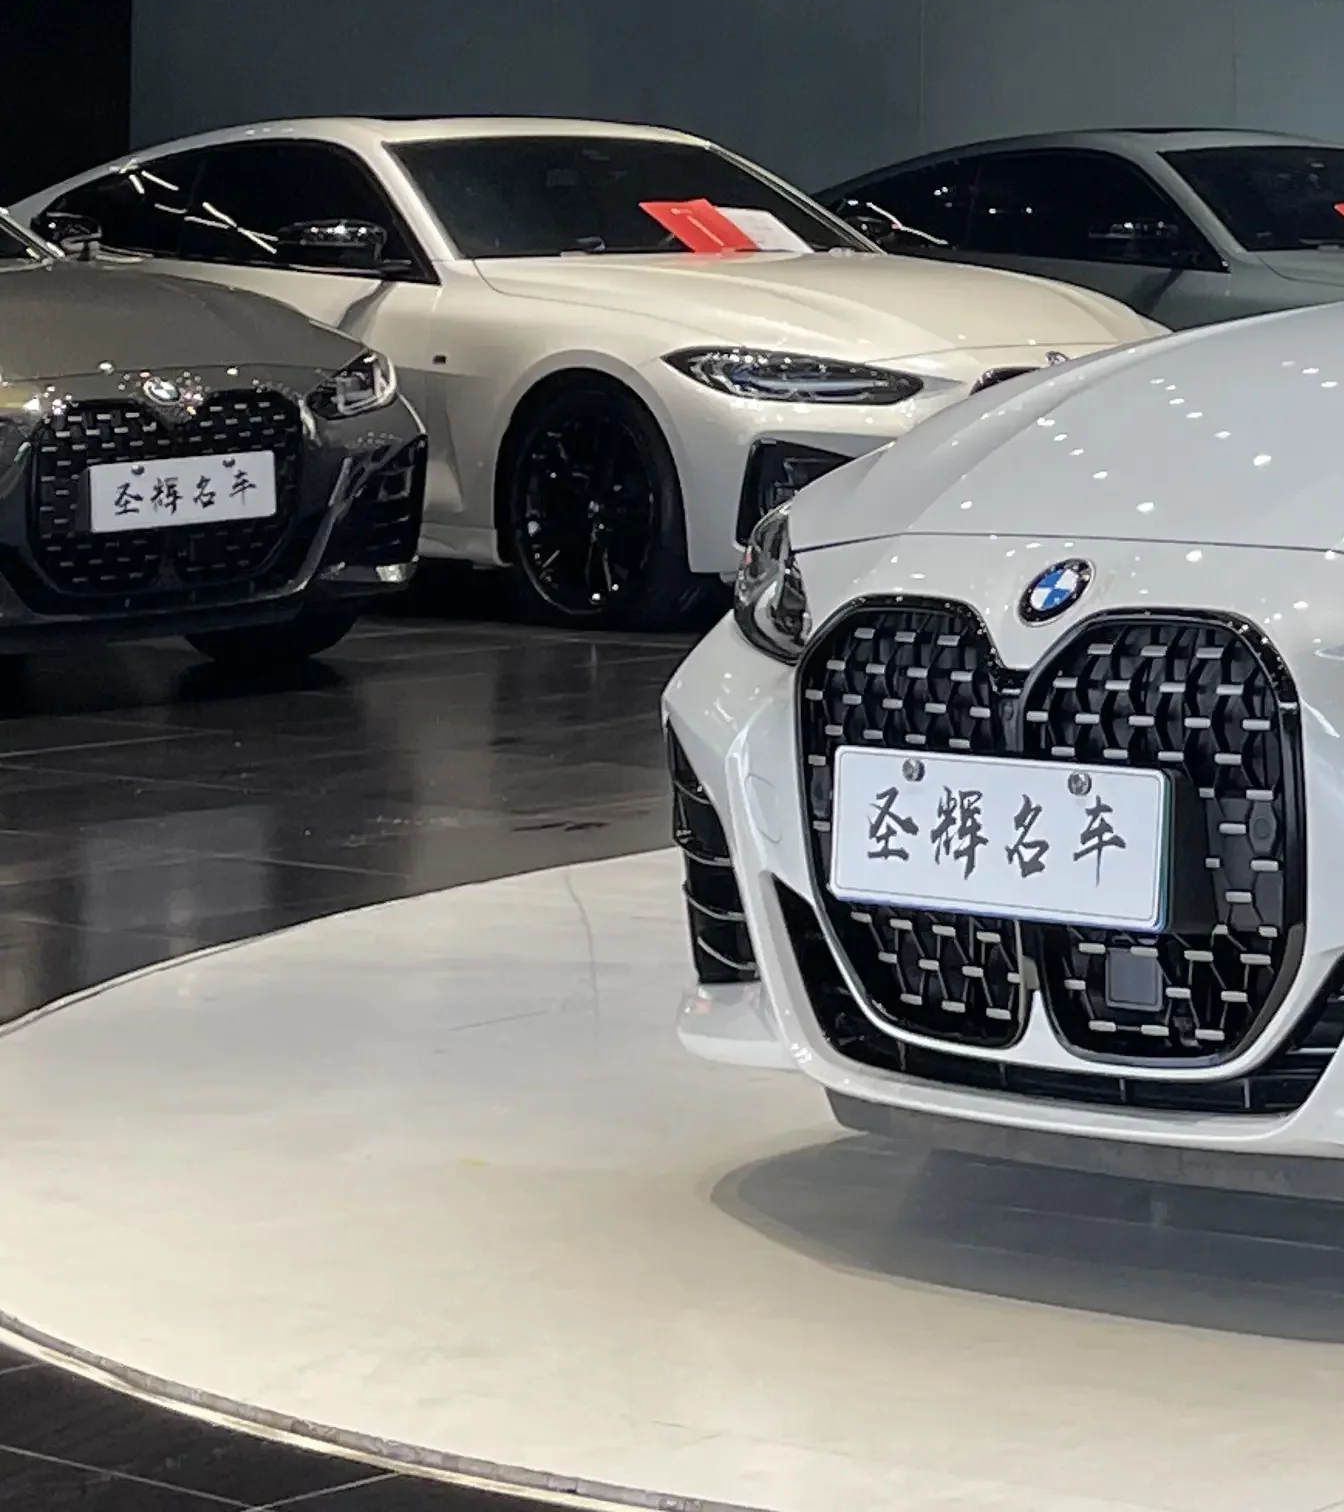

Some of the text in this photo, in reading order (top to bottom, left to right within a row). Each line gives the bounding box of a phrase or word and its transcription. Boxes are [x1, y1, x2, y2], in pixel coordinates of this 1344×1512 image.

[114, 469, 257, 516] 圣辉名车
[868, 786, 1126, 888] 圣辉名车
